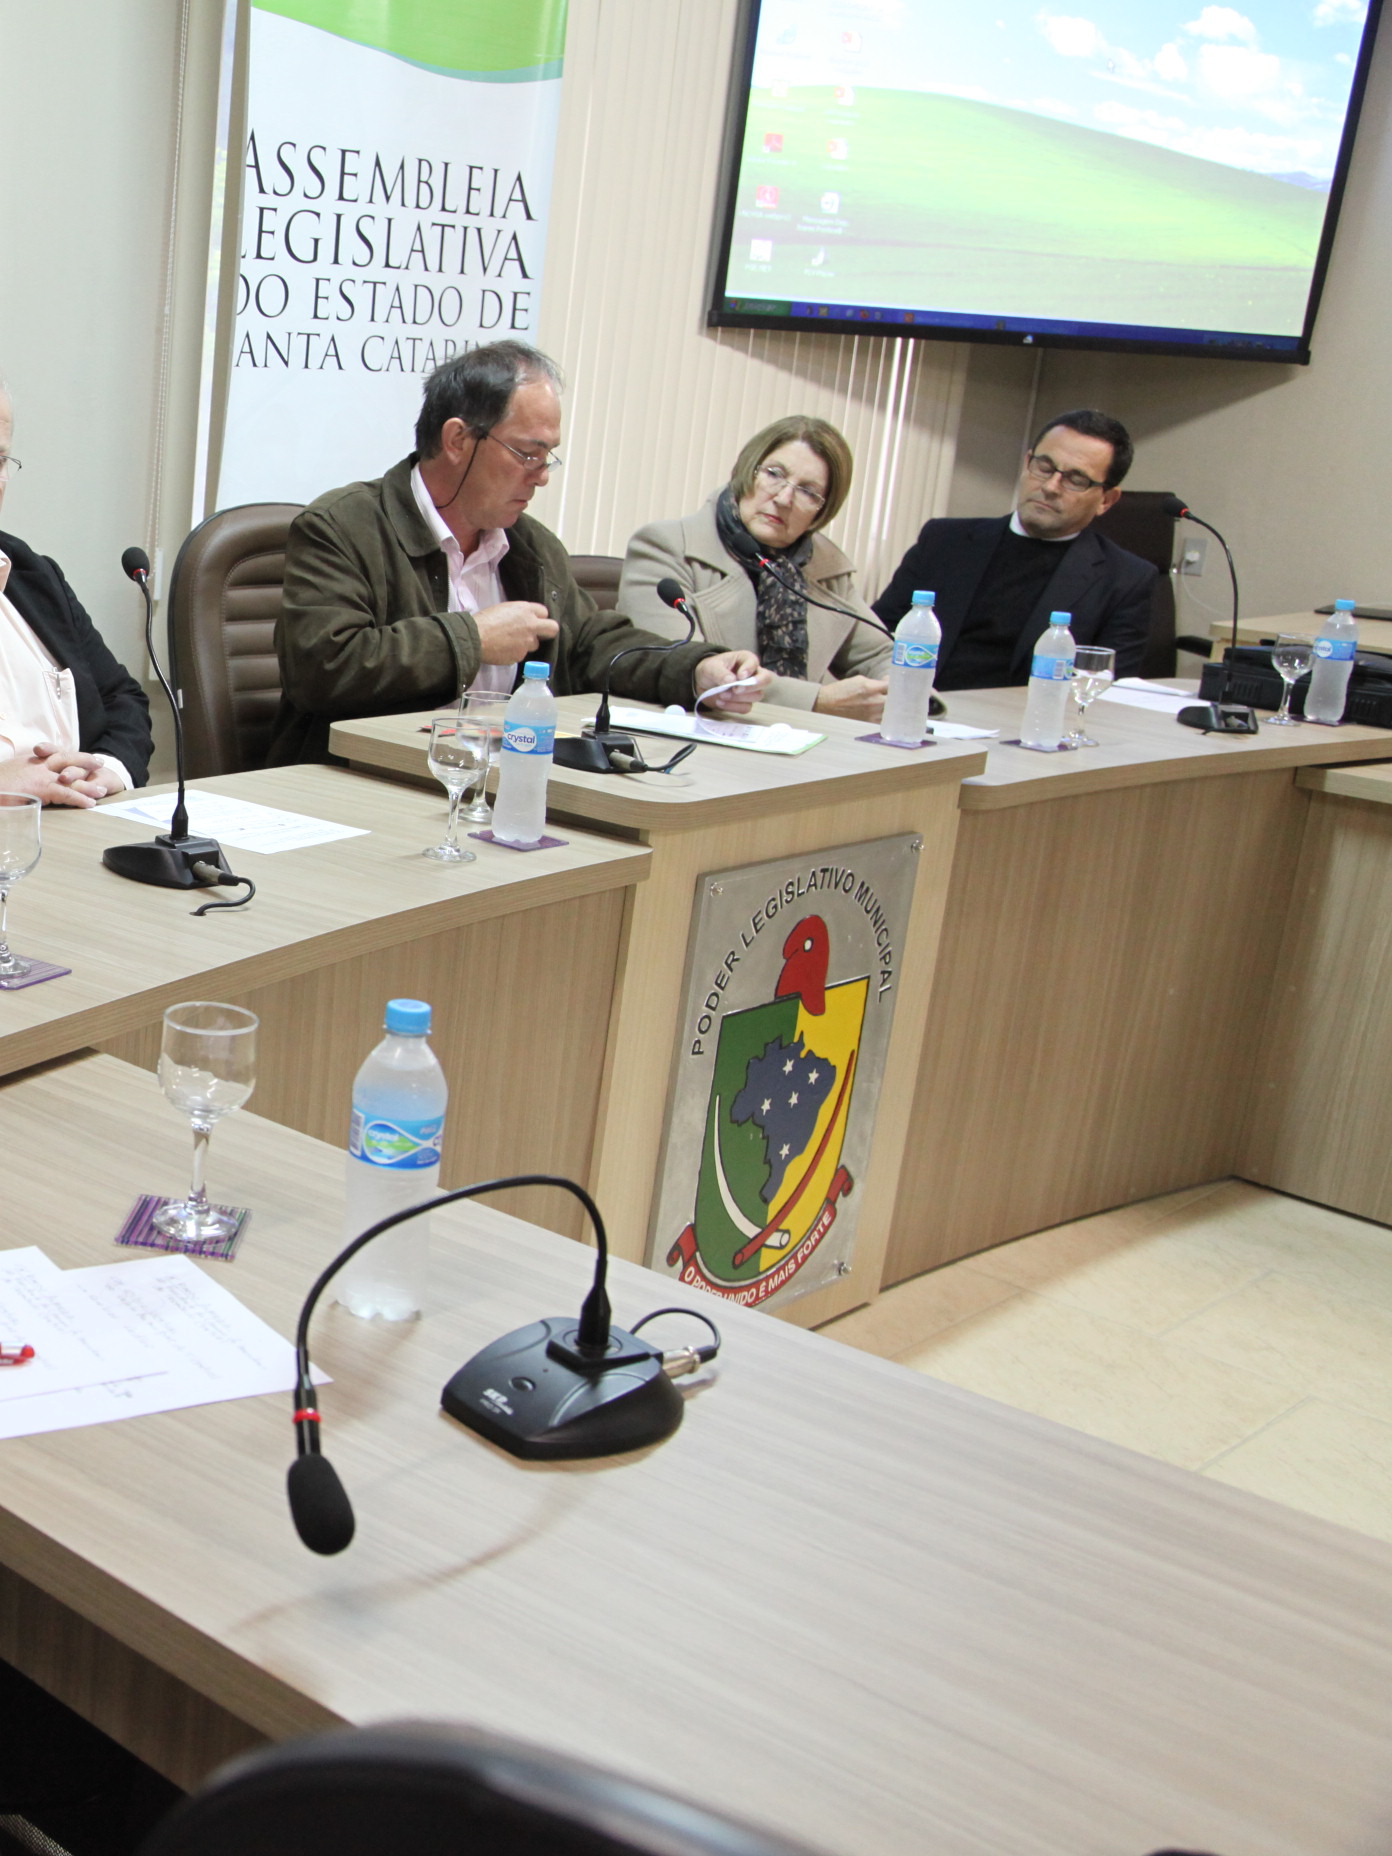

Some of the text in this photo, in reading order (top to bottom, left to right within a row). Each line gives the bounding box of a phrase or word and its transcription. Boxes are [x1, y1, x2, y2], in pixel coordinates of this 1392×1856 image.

[245, 128, 538, 222] ASSEMBLEIA
[240, 206, 534, 280] EGISLATIVA
[310, 276, 464, 328] ESTADO
[477, 288, 532, 331] DE
[234, 329, 347, 371] ANTA
[507, 732, 537, 745] crystal
[691, 867, 894, 1057] PODER LEGISLATIVO MUNICIPAL
[684, 1265, 695, 1283] O
[758, 1281, 767, 1297] É
[768, 1261, 796, 1292] MAIS
[796, 1211, 833, 1264] FORTE
